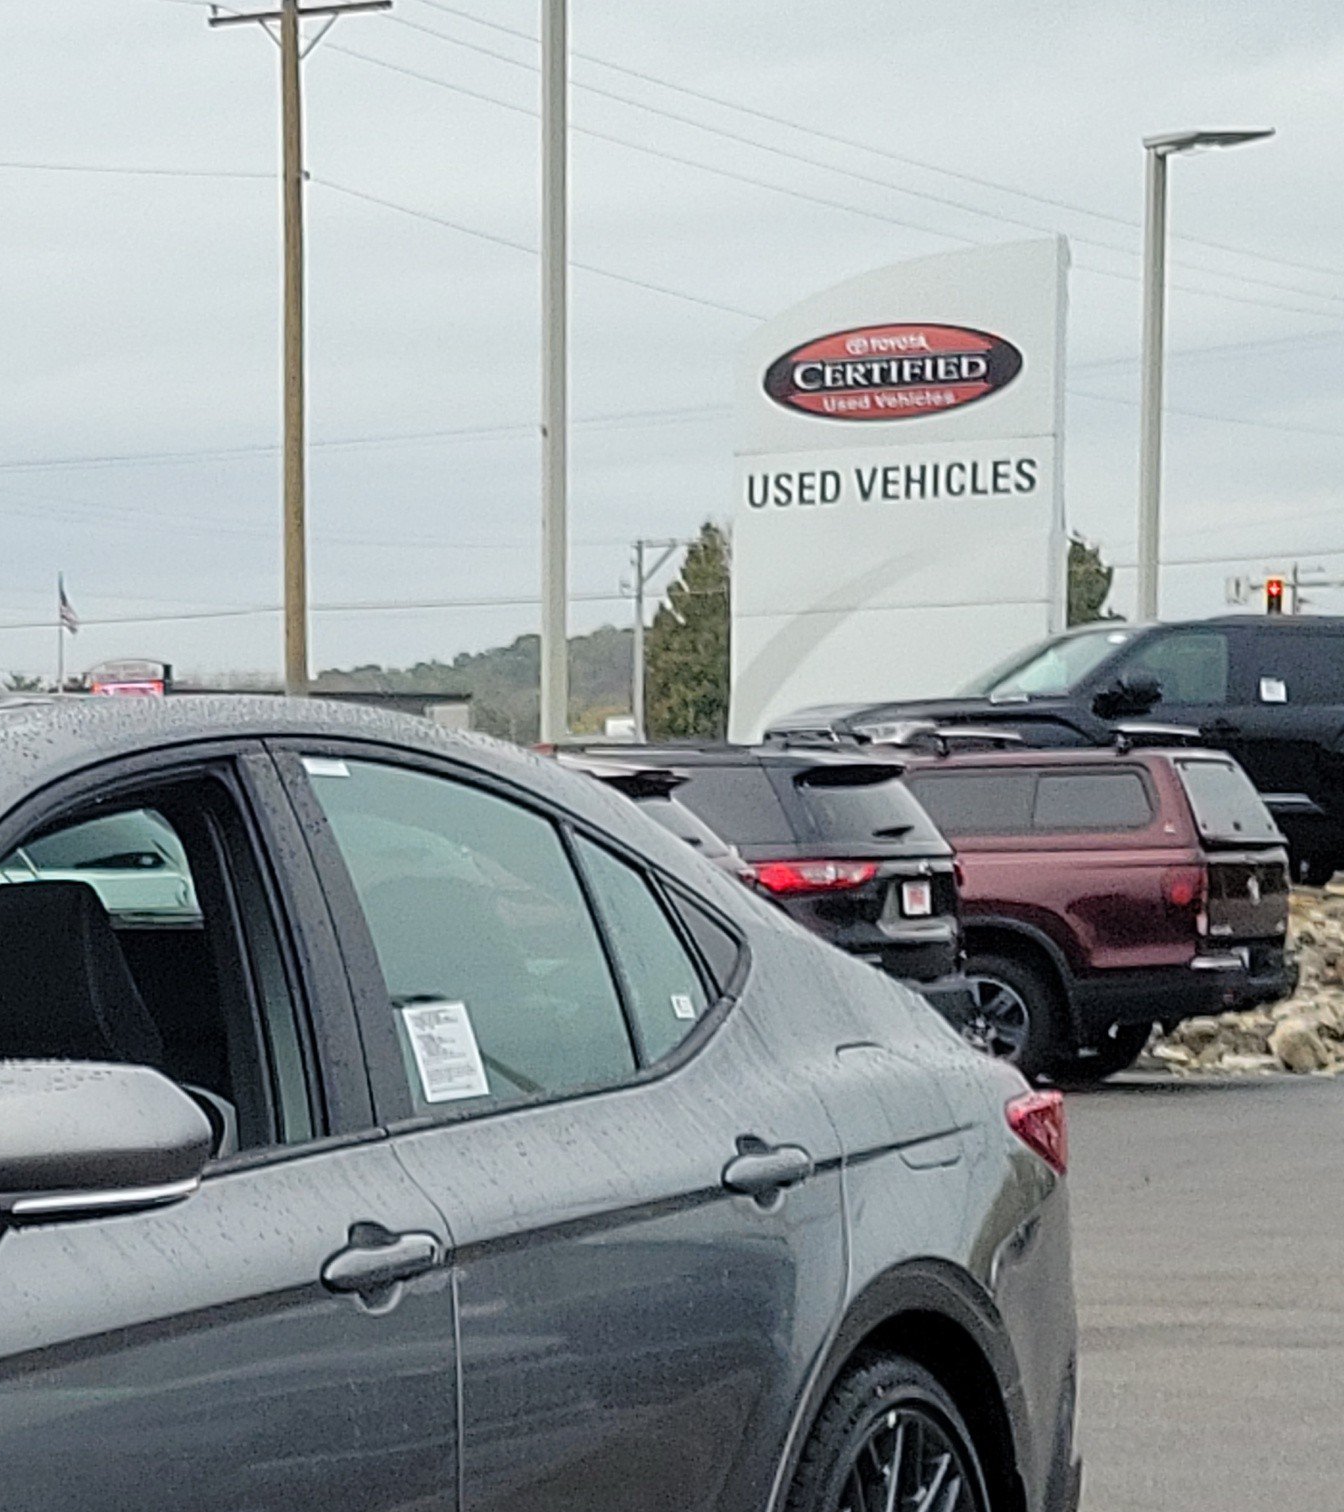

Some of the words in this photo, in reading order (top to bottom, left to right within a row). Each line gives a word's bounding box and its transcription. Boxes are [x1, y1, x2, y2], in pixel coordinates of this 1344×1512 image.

[792, 354, 988, 391] CERTIFIED
[822, 393, 872, 412] Used
[874, 389, 956, 409] Vehicles
[747, 469, 842, 509] USED
[855, 458, 1038, 501] VEHICLES
